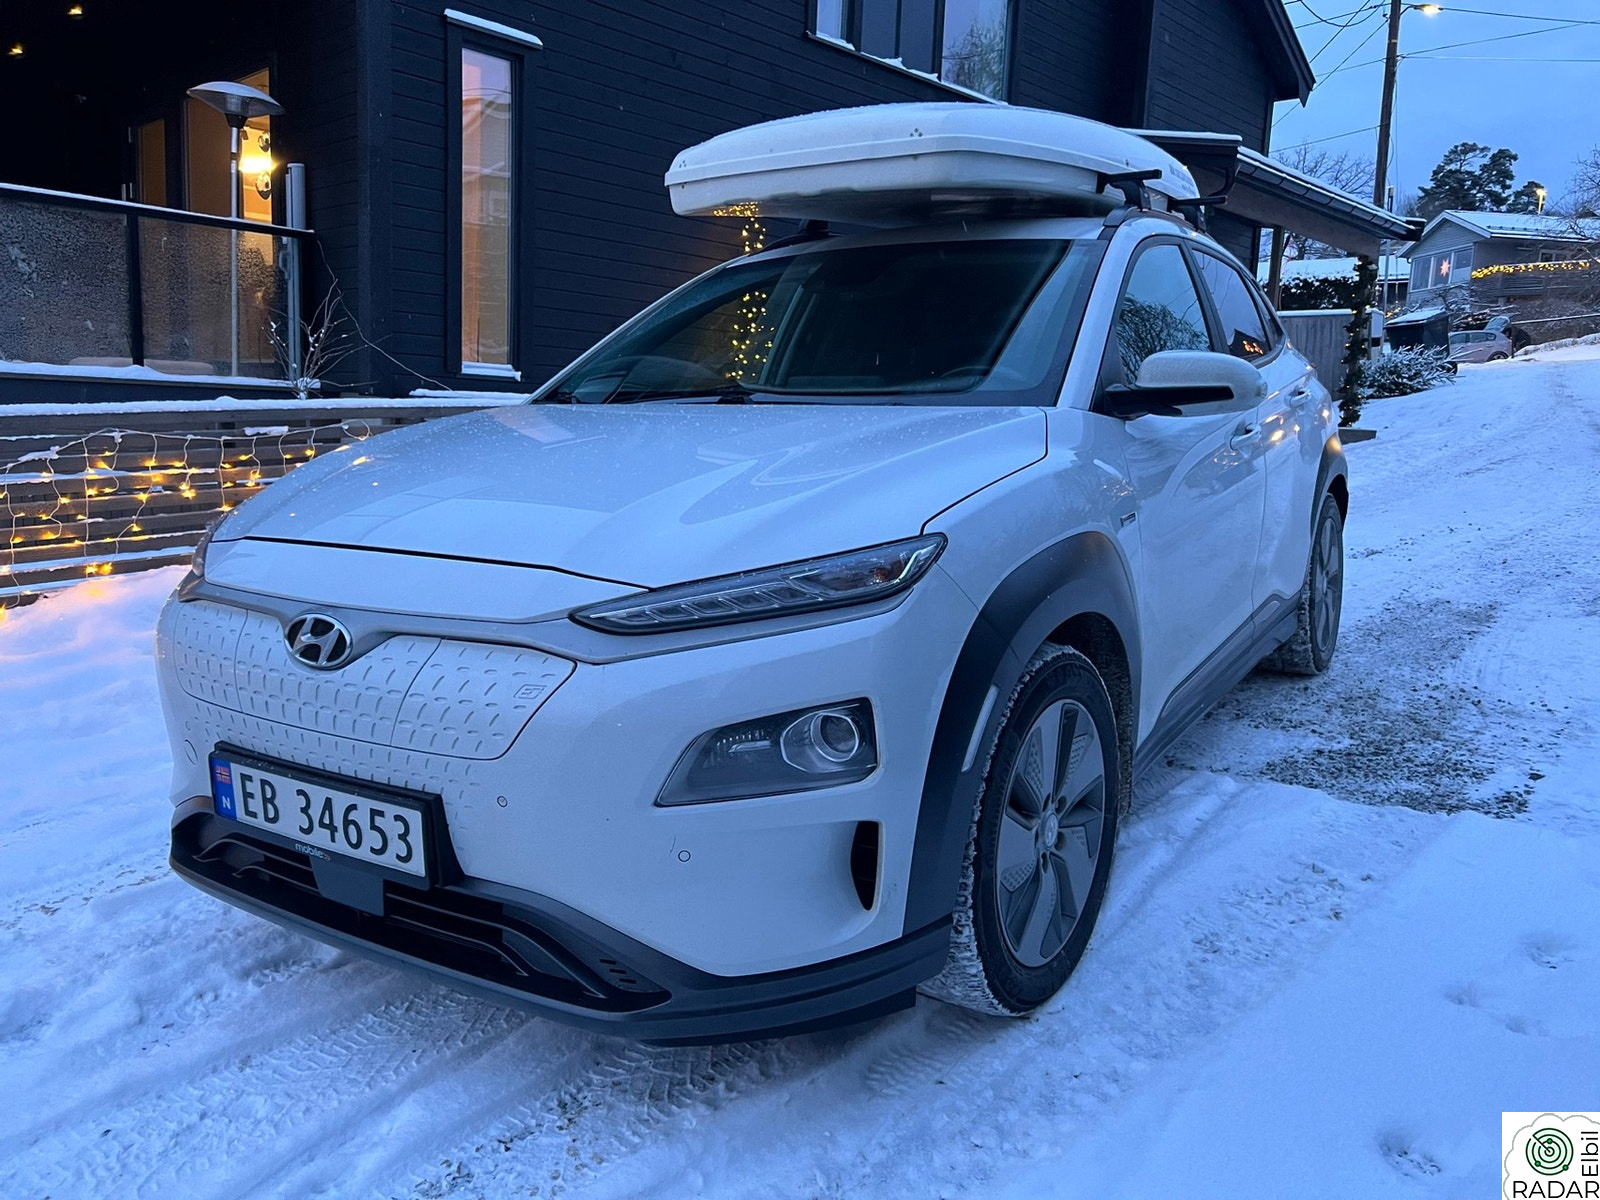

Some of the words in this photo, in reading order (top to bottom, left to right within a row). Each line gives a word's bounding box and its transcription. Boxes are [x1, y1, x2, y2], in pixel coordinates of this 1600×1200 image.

[222, 795, 232, 811] N
[240, 773, 280, 825] EB
[296, 789, 413, 864] 34653
